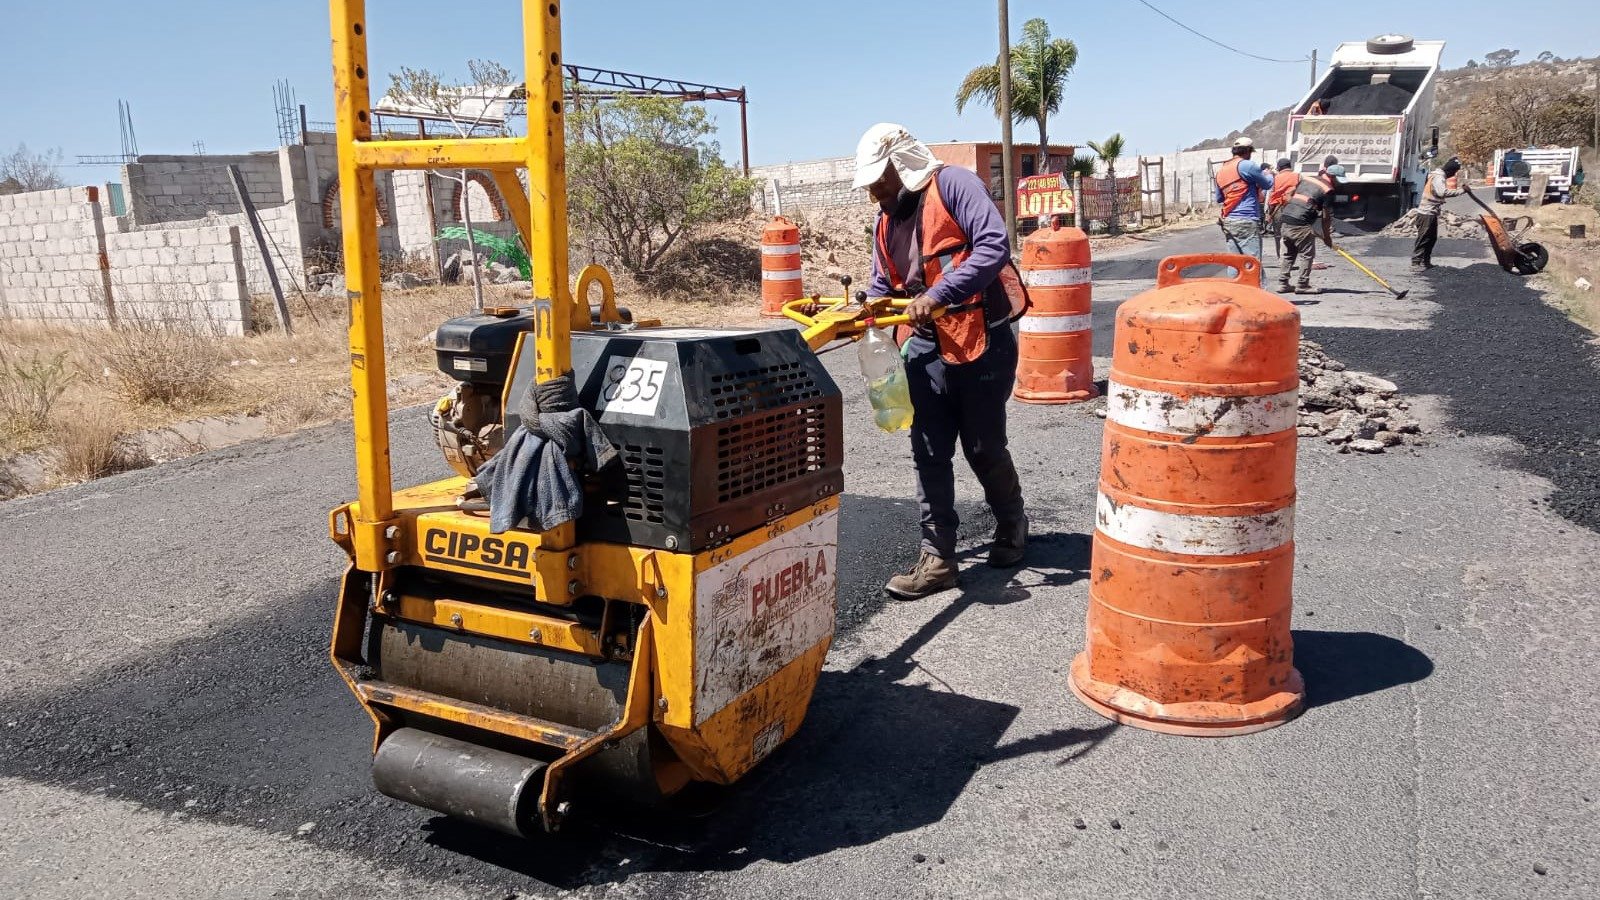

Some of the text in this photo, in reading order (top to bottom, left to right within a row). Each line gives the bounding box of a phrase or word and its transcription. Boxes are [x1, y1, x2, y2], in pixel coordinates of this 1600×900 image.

[1344, 147, 1358, 155] del
[1360, 147, 1392, 155] Estado
[1347, 138, 1374, 147] cargo
[1376, 137, 1391, 145] del
[1020, 189, 1073, 215] LOTES
[603, 364, 663, 402] 835
[425, 528, 530, 570] CIPSA
[752, 549, 827, 617] PUEBLA
